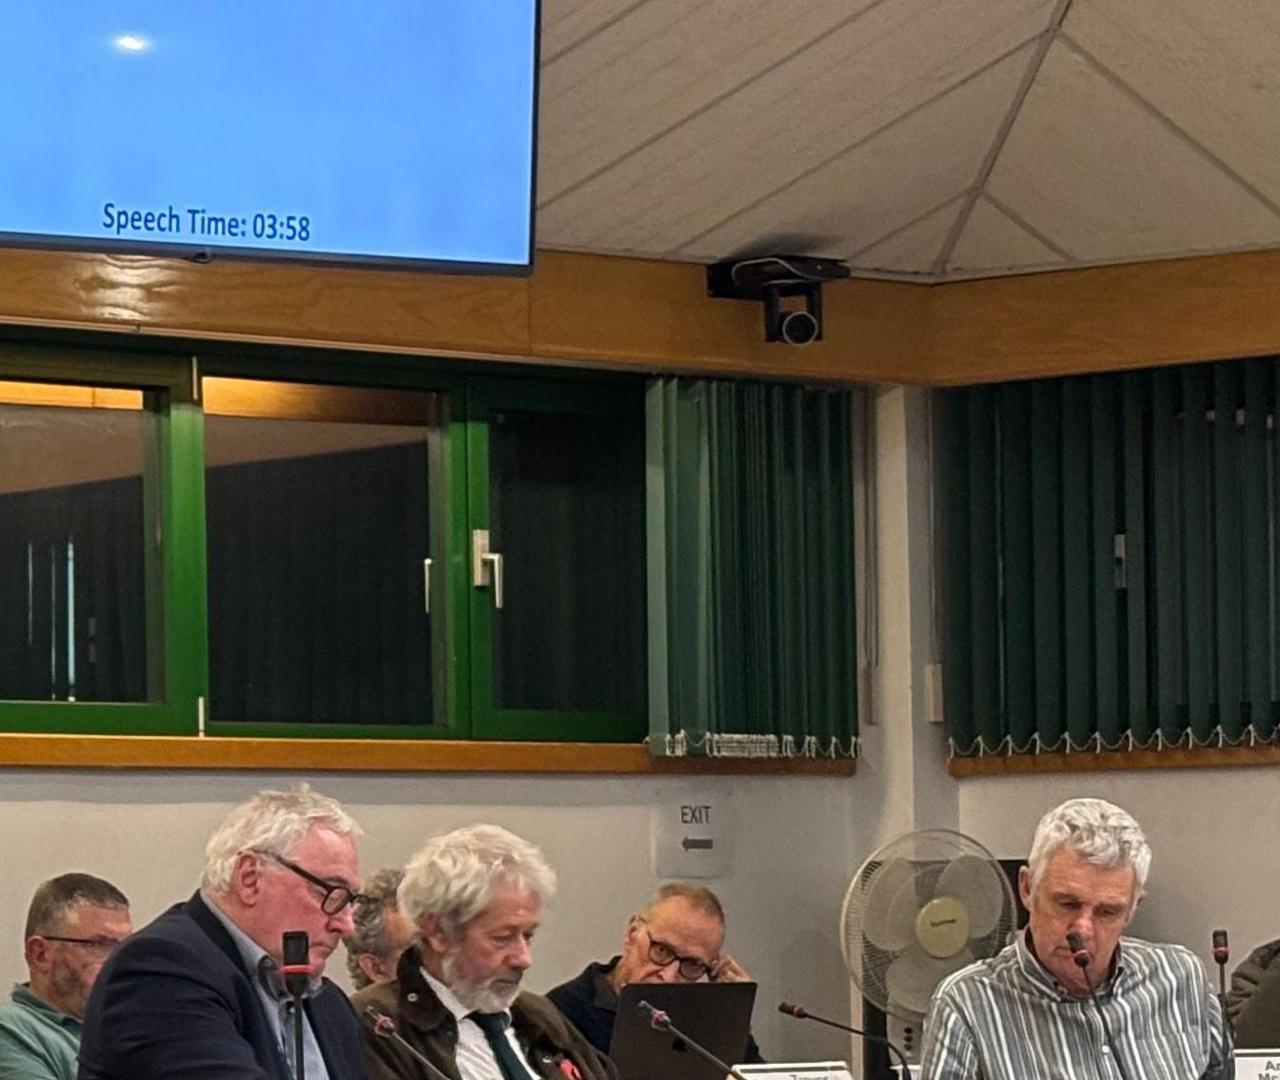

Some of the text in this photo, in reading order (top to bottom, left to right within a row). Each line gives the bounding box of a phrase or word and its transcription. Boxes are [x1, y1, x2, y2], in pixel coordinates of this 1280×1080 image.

[102, 203, 311, 241] Speech Time: 03:58
[680, 805, 711, 824] EXIT
